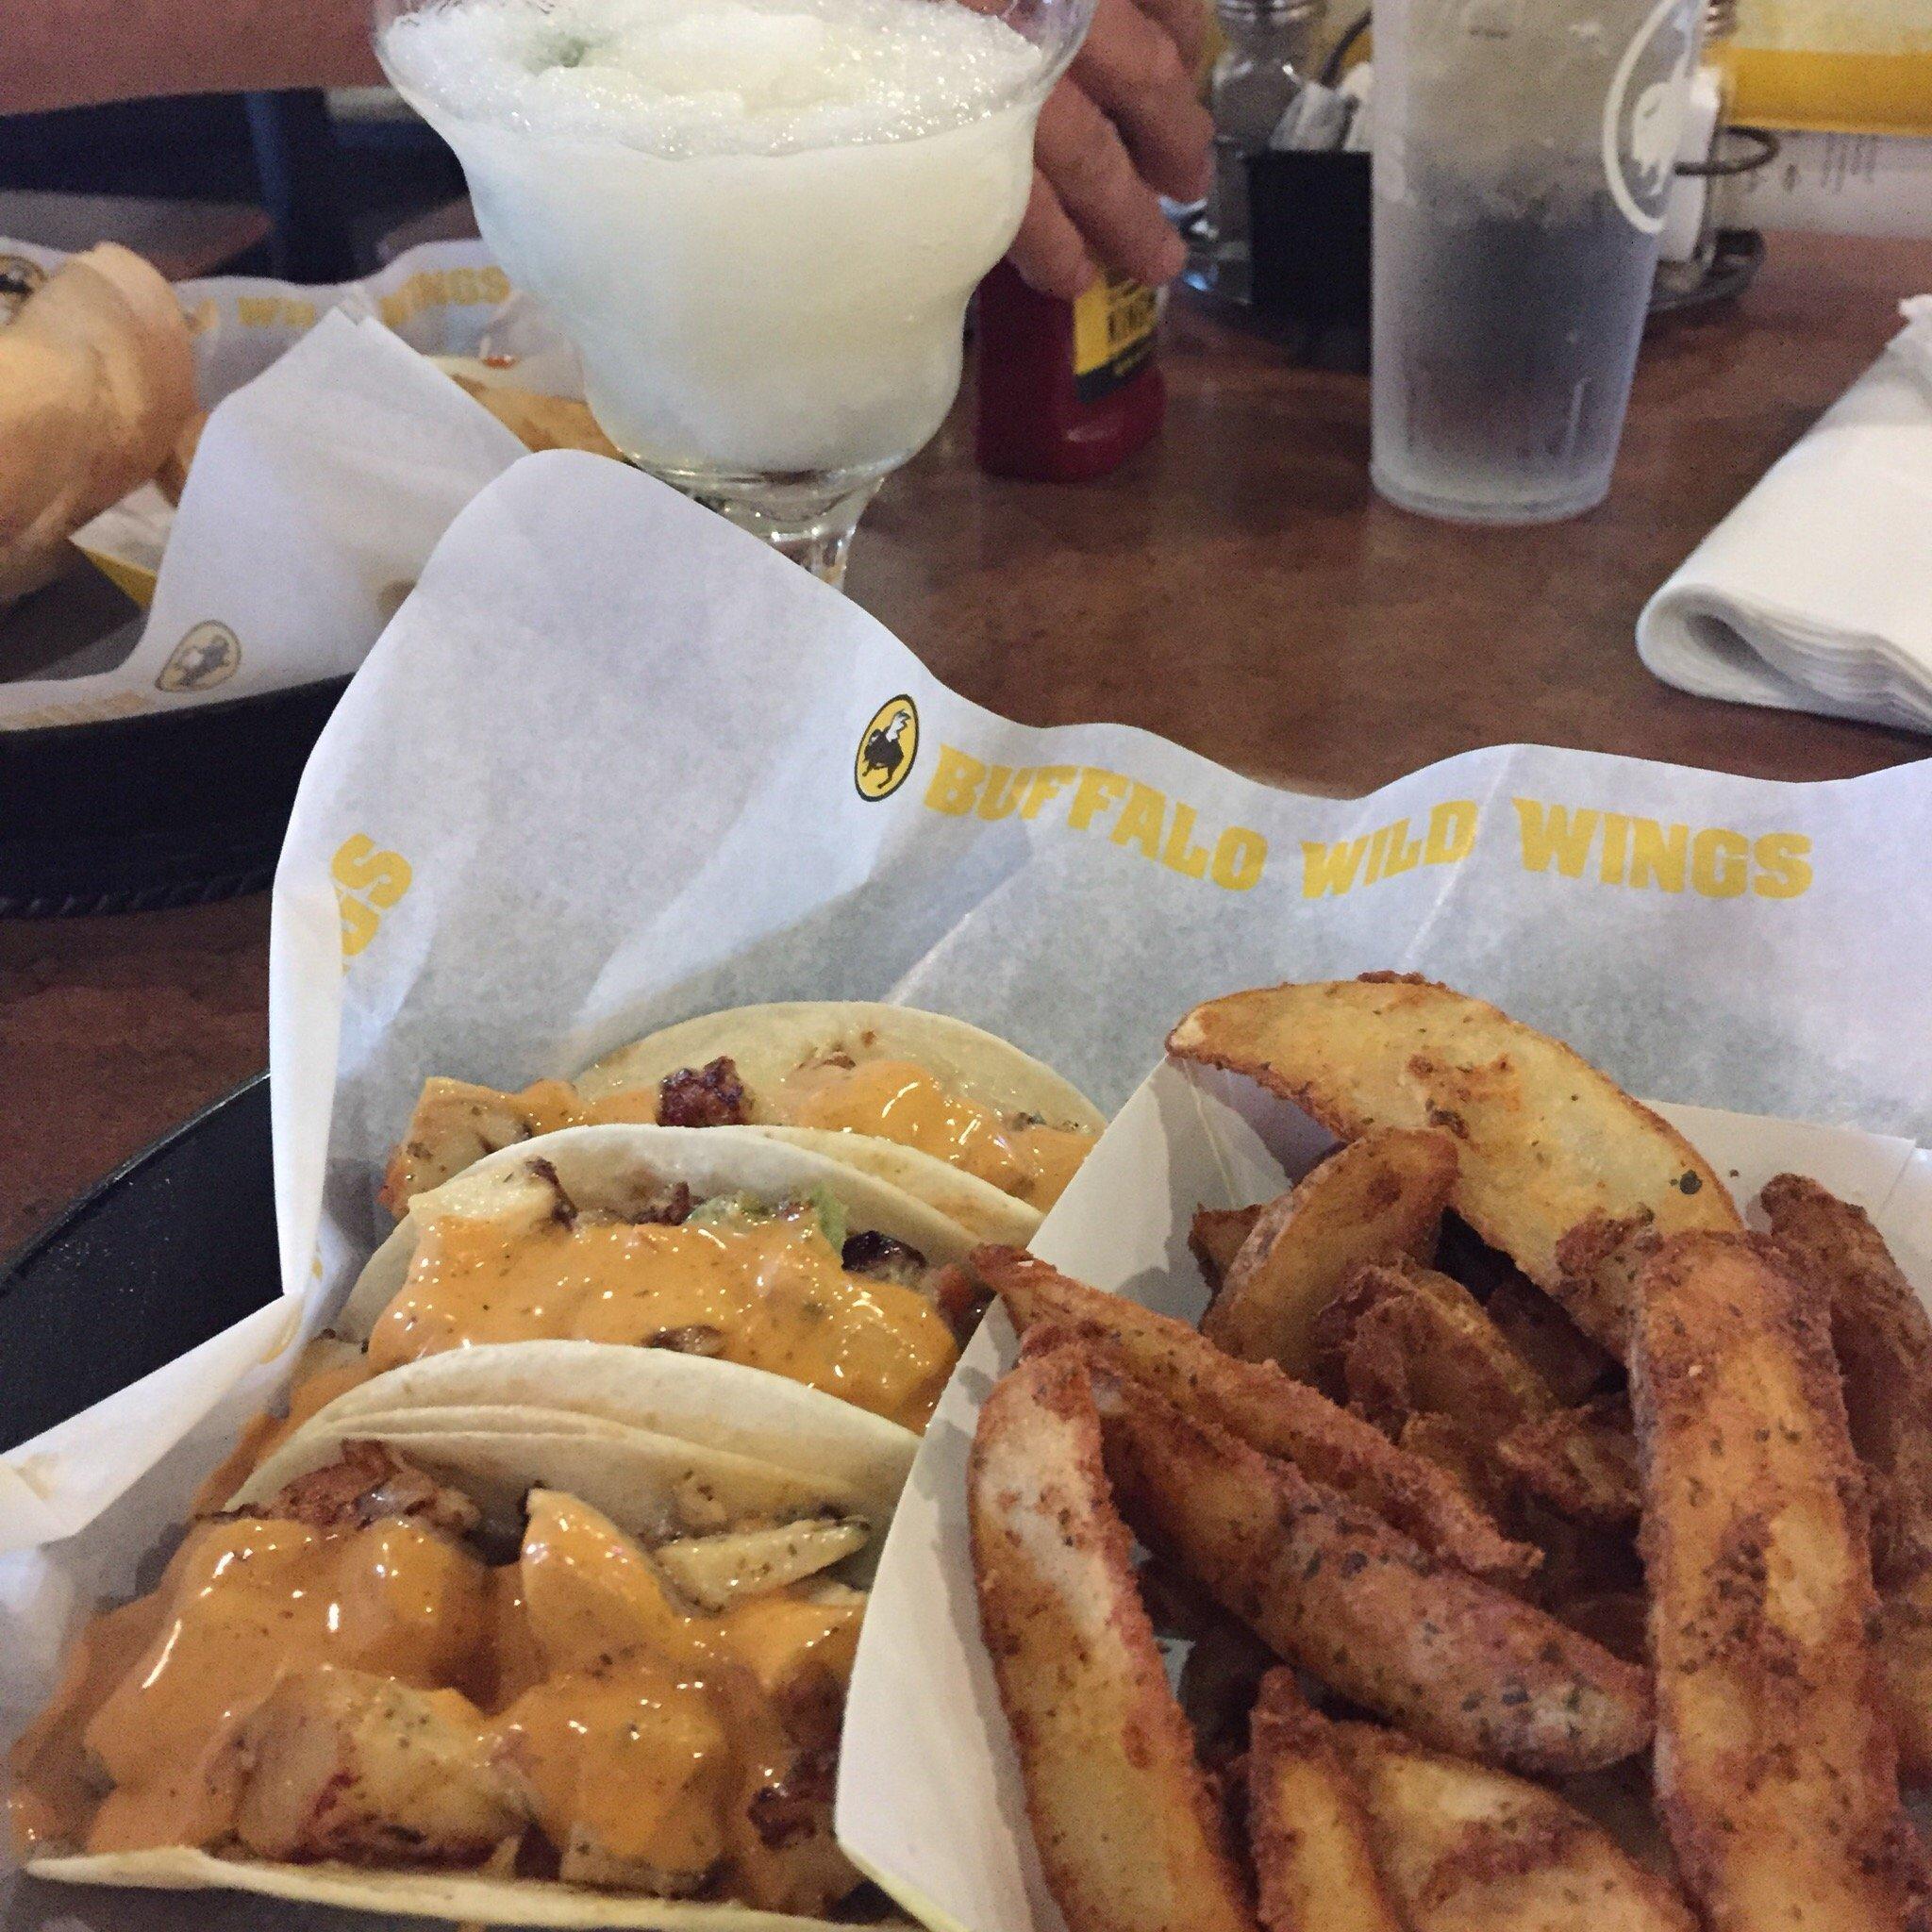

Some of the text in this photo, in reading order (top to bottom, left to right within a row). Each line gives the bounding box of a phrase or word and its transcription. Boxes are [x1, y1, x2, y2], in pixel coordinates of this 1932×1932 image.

[924, 743, 1813, 899] BUFFALO WILD WINGS
